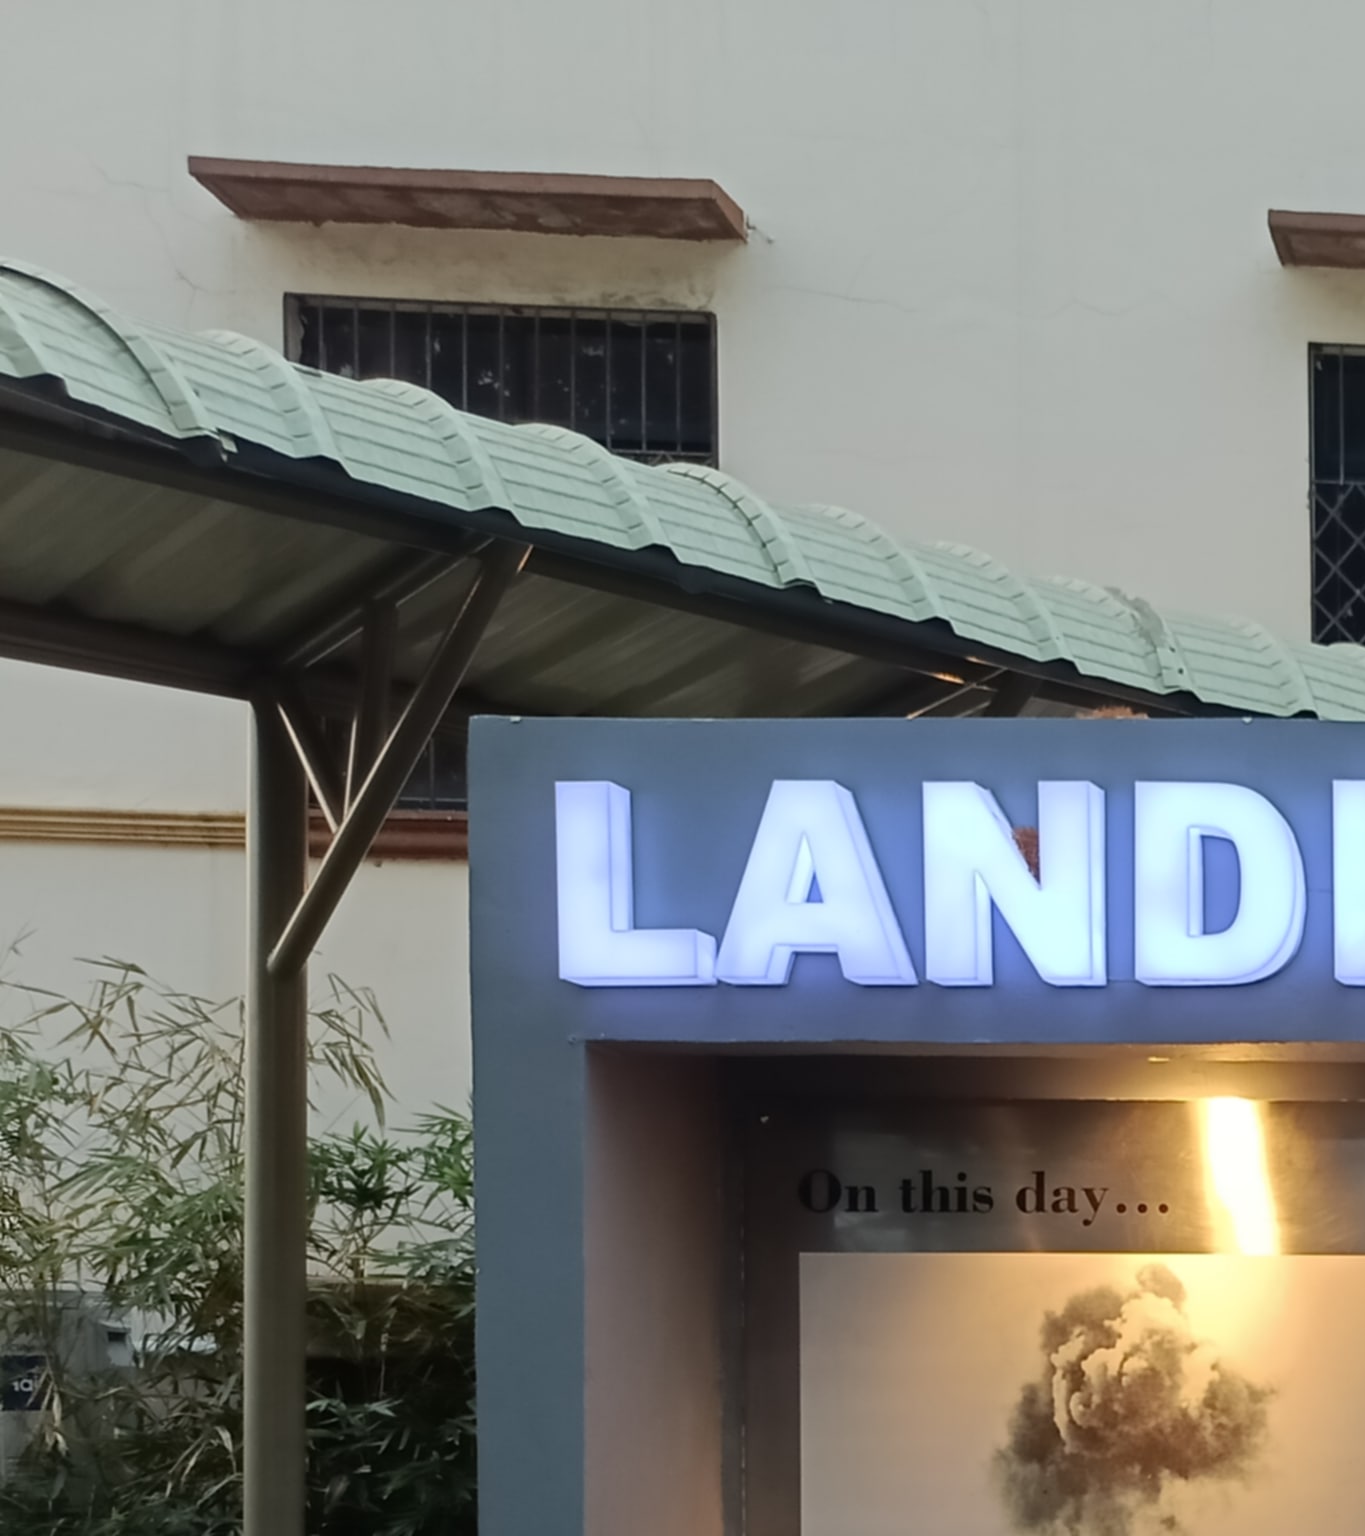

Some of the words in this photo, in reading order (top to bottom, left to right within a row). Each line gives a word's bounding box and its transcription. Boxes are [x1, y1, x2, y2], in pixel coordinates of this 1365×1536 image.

[799, 1168, 879, 1214] On
[900, 1169, 995, 1214] this
[1014, 1170, 1170, 1227] day...
